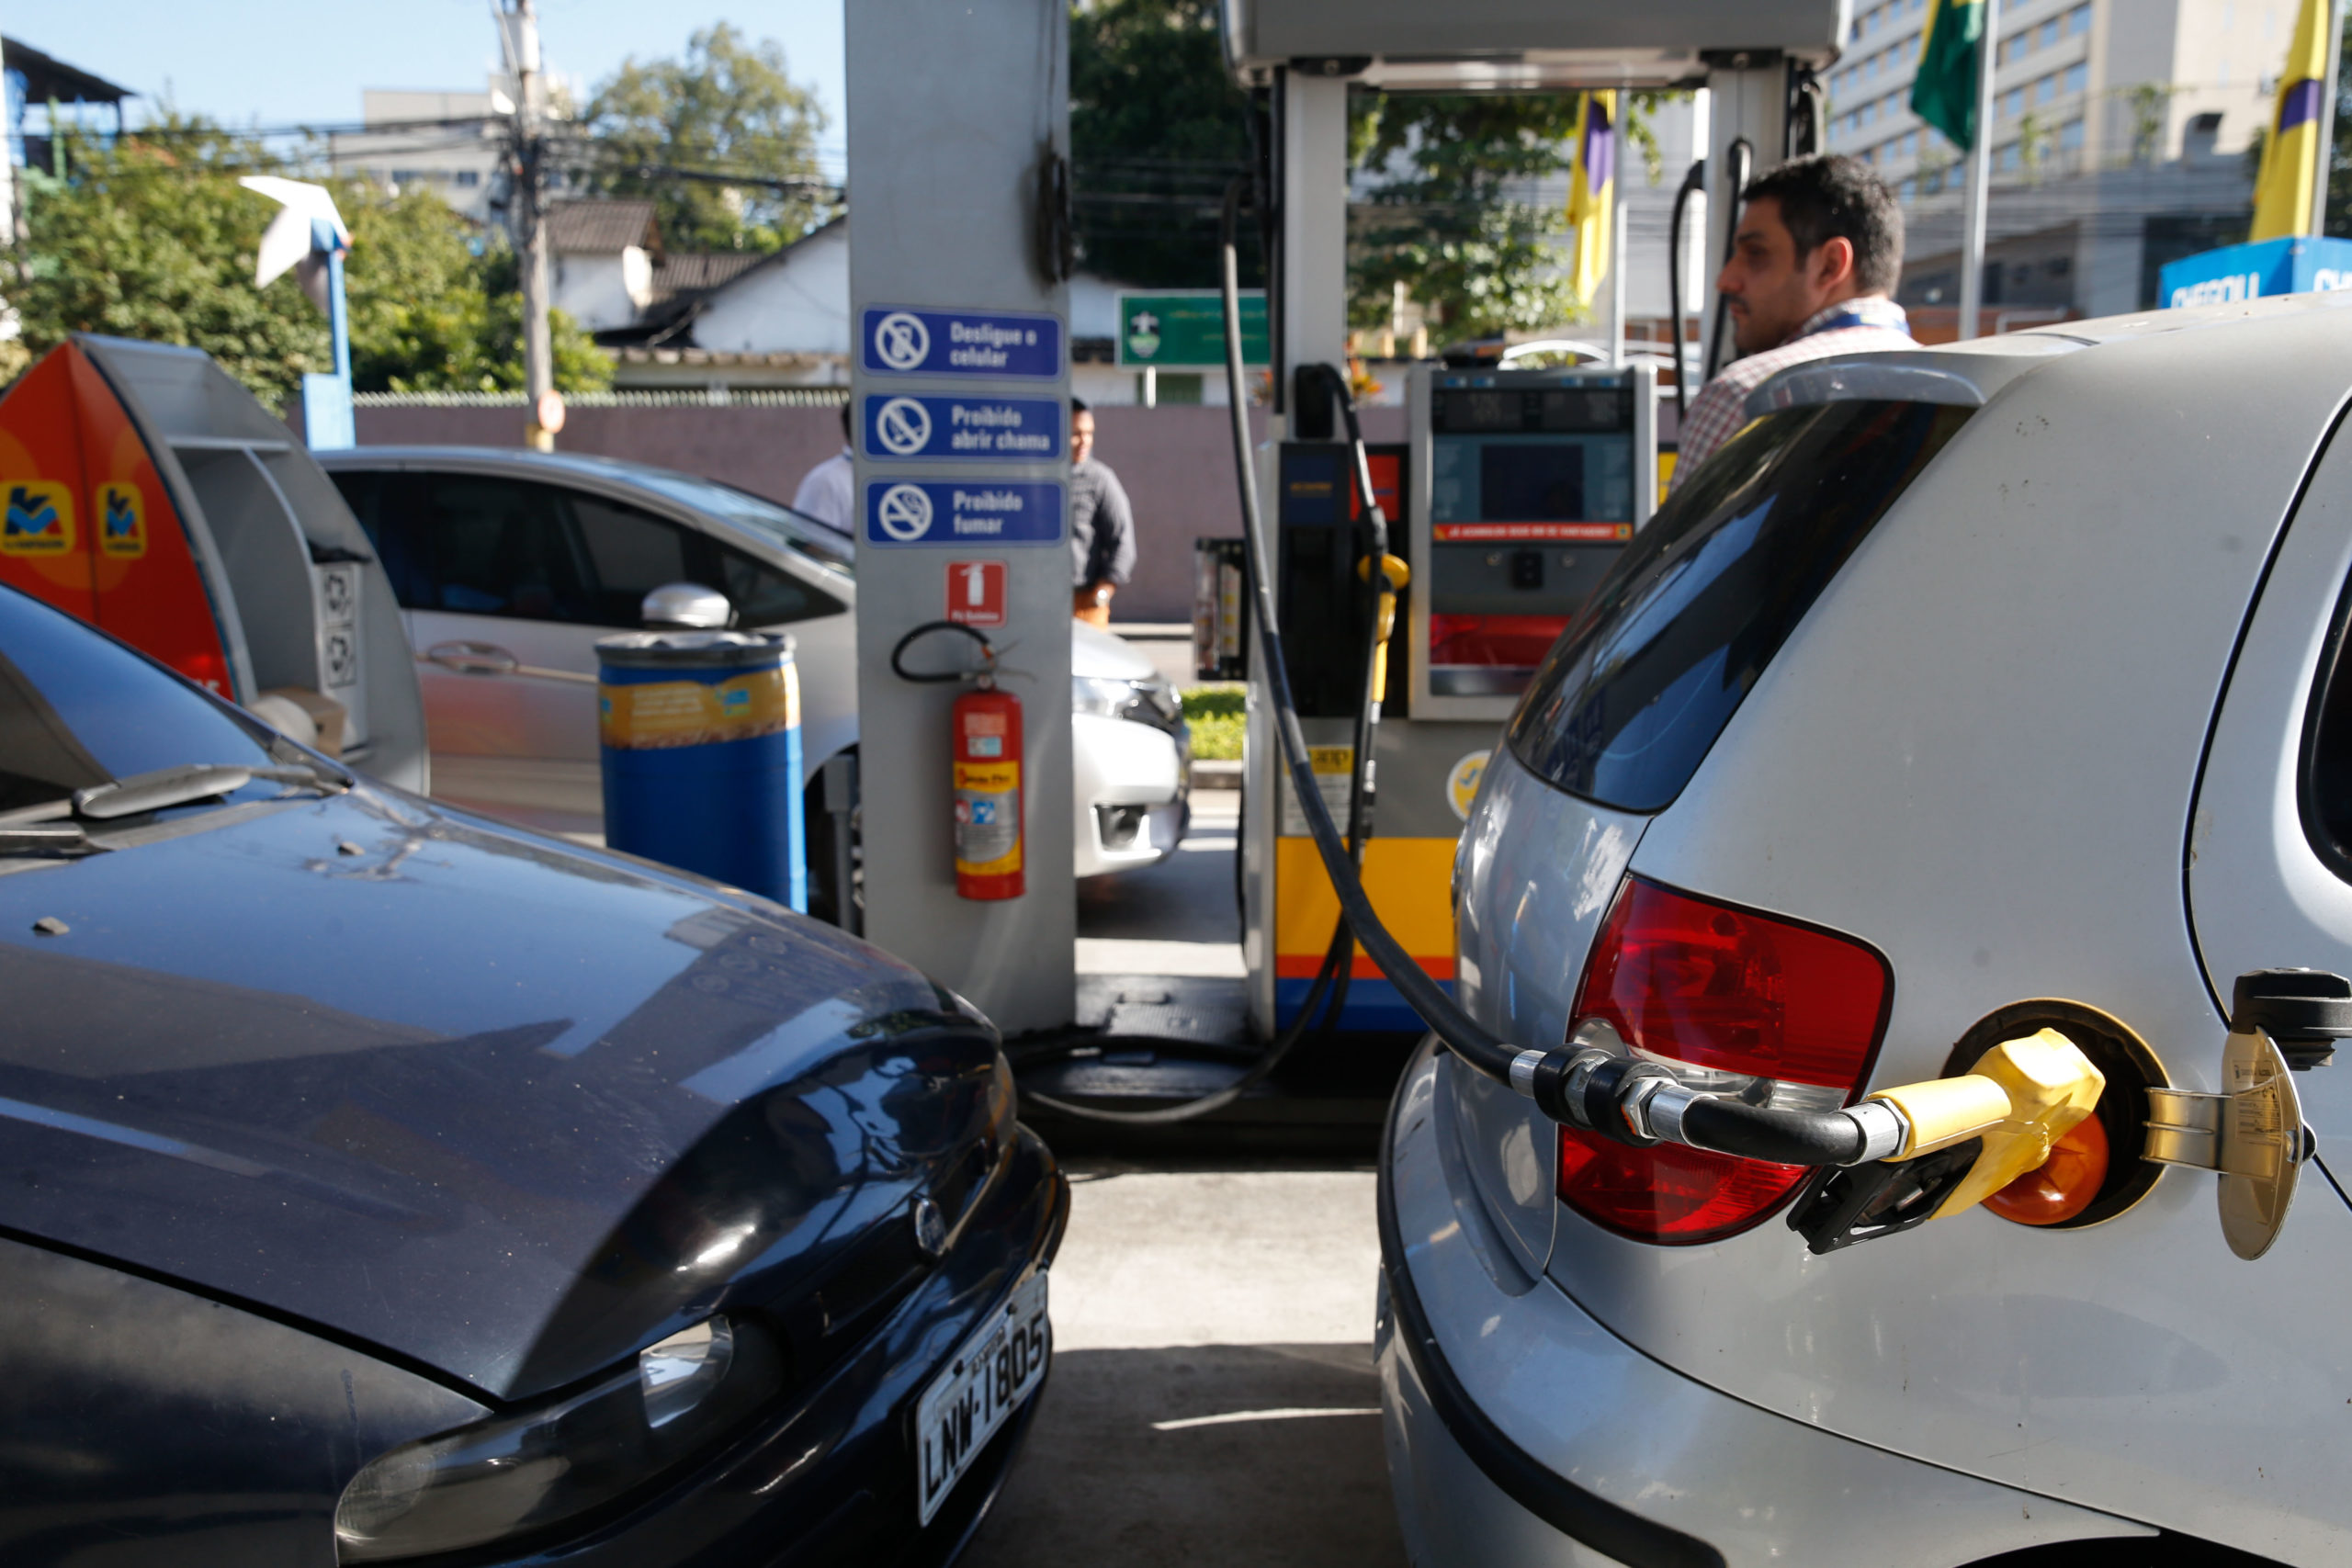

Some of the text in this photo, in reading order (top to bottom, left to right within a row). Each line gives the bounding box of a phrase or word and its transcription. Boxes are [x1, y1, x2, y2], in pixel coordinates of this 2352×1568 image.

[950, 321, 1037, 348] Desligue o
[950, 348, 1007, 367] celular
[952, 405, 1022, 427] Proibido
[952, 430, 1050, 450] abrir chama
[953, 491, 1023, 512] Proibido
[954, 514, 1003, 534] fumar
[925, 1308, 1044, 1504] LNW-1805
